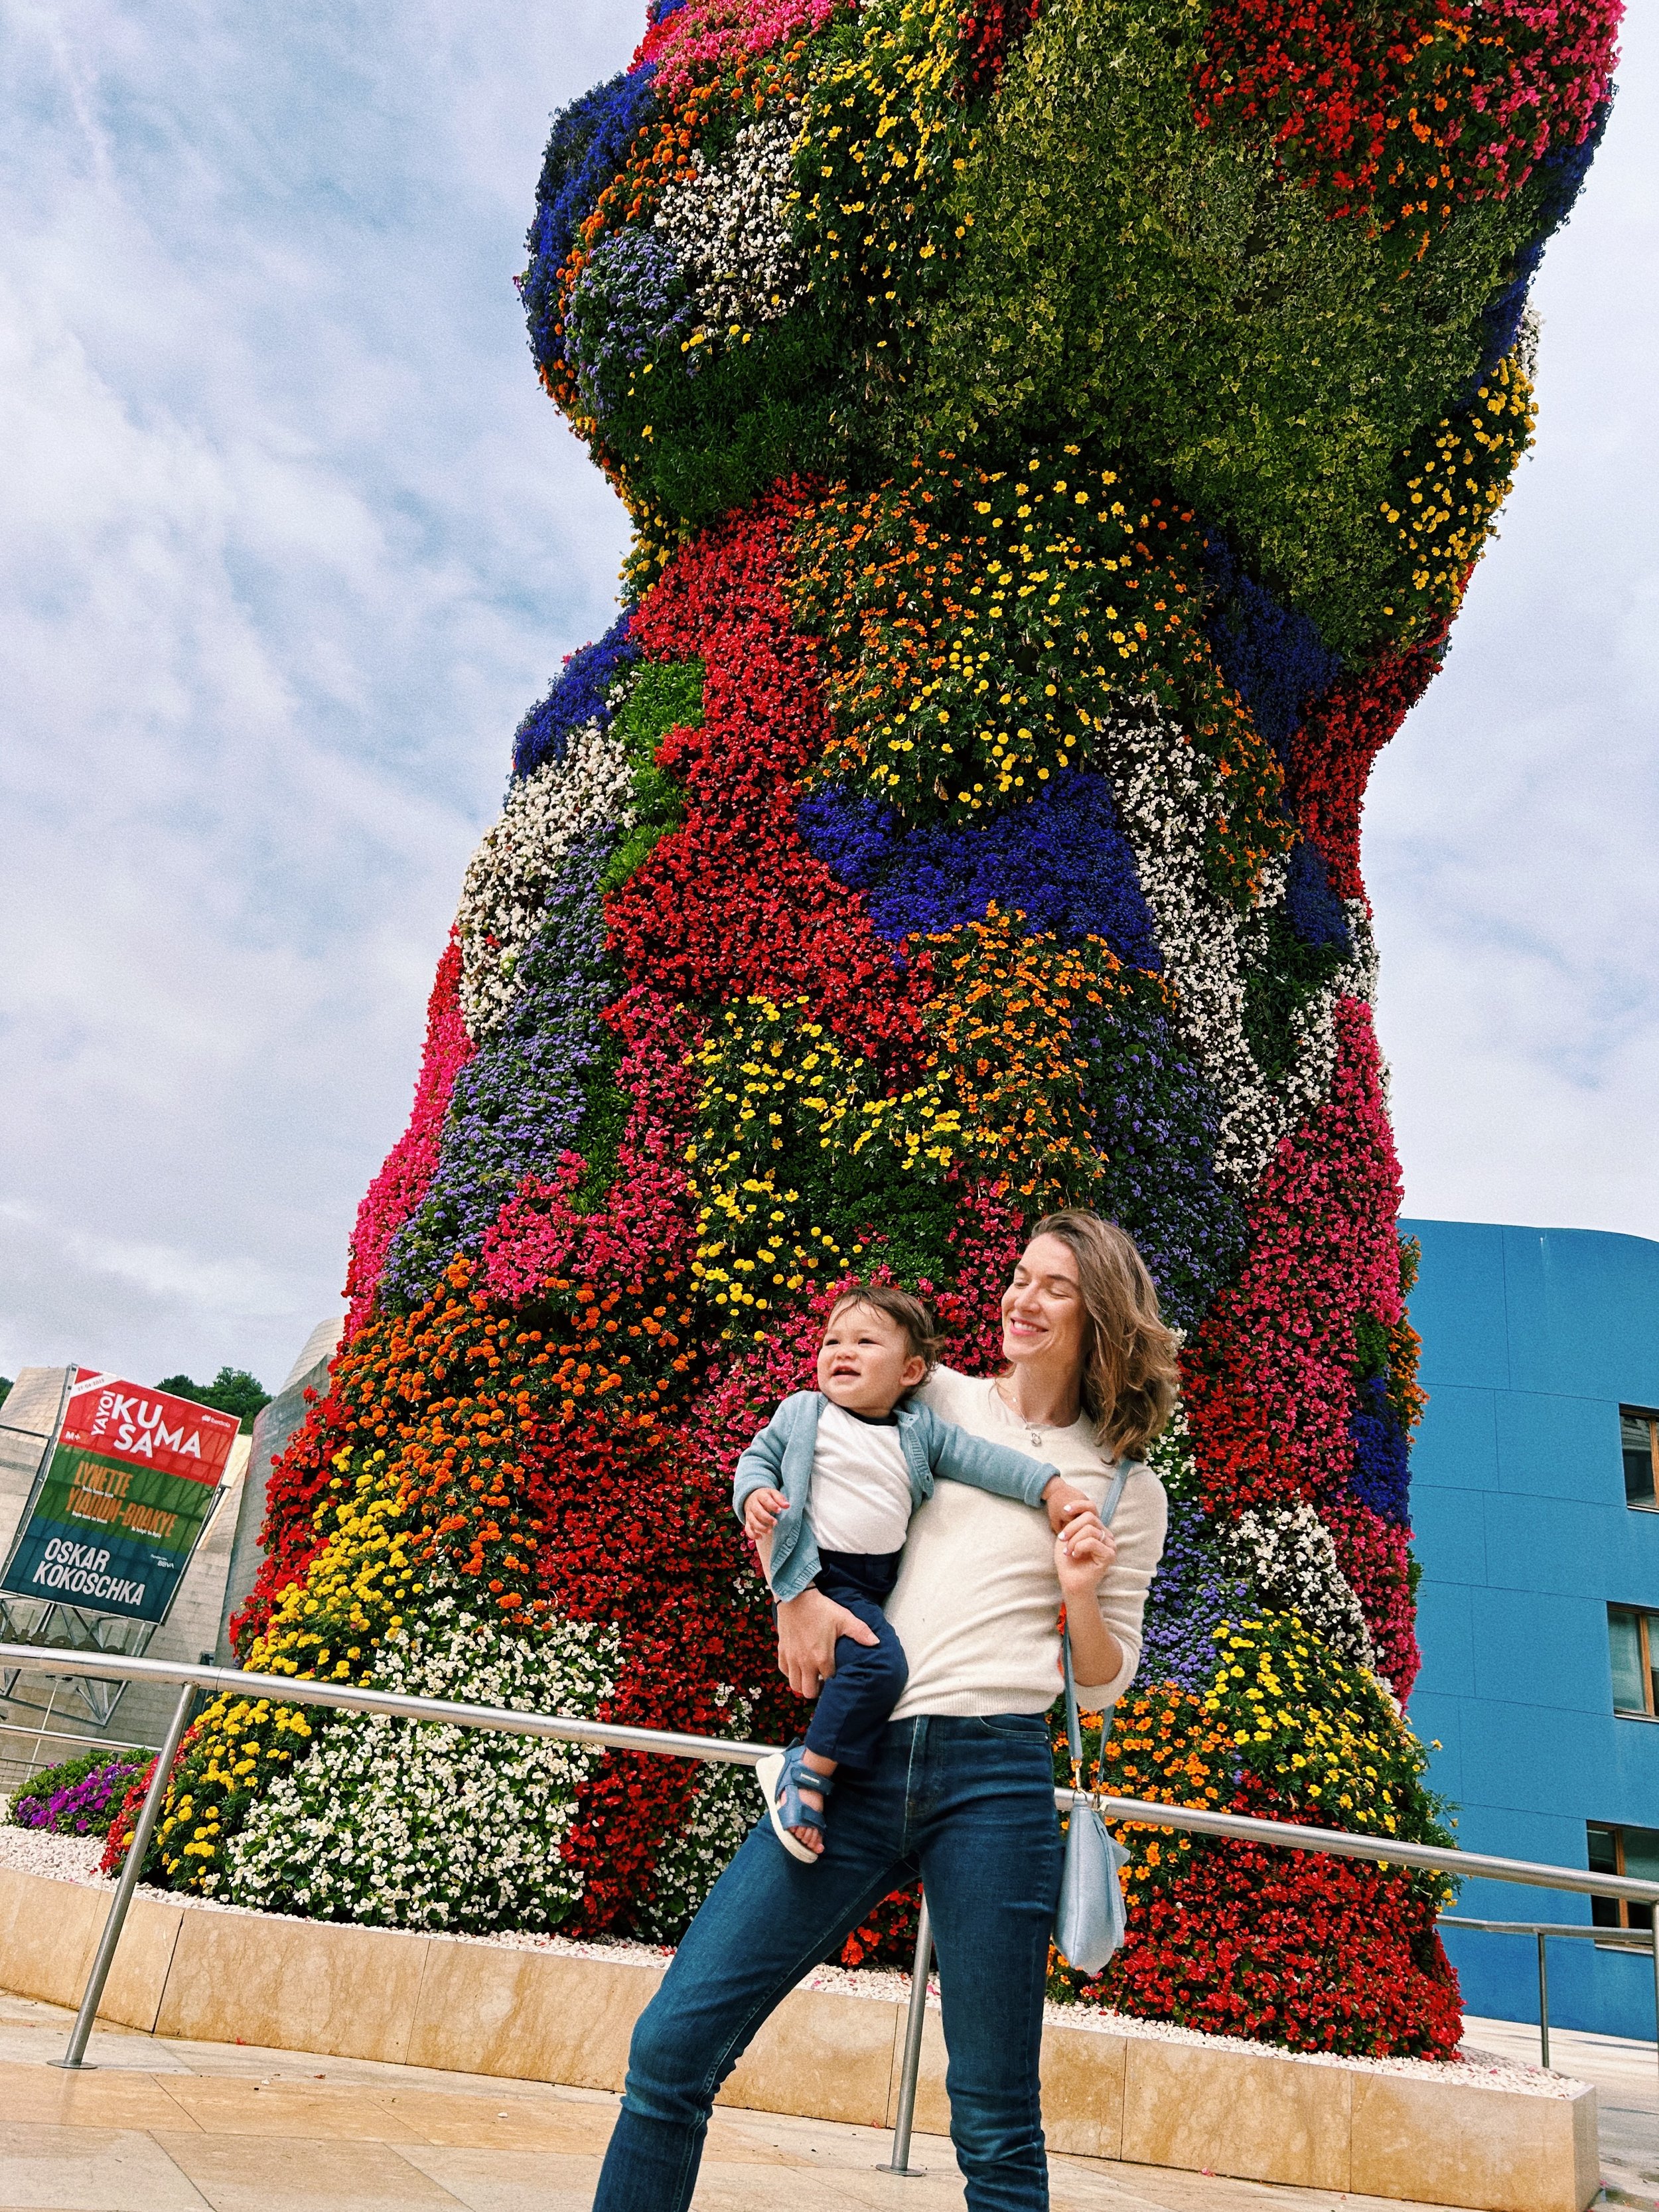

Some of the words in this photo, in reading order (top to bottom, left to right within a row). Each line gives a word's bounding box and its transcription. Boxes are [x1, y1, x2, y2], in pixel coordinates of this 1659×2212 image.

[91, 1390, 116, 1436] YAYOI
[74, 1460, 133, 1498] LYNETTE
[66, 1487, 179, 1538] YIADOM-BOAKYE
[44, 1537, 111, 1573] OSKAR
[33, 1560, 145, 1605] KOKOSCHKA
